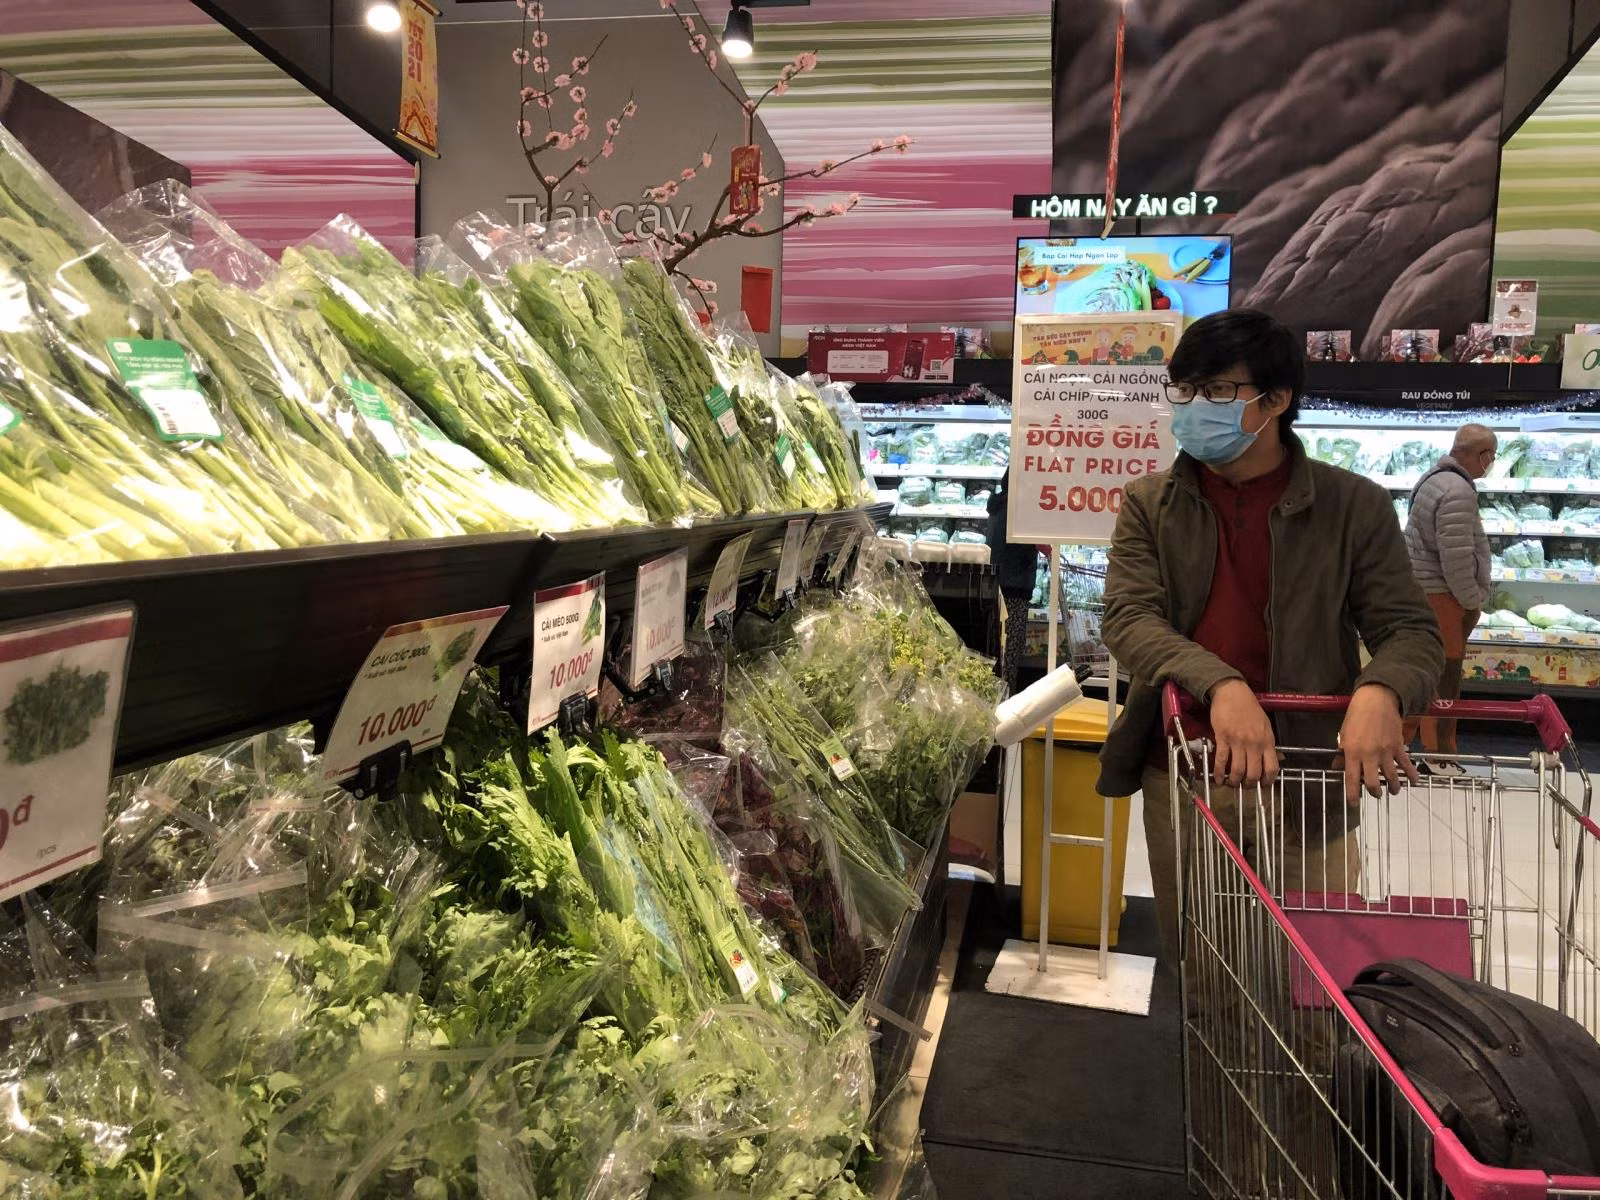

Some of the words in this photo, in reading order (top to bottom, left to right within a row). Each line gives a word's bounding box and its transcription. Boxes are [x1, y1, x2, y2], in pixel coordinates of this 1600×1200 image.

[1031, 195, 1080, 218] HÔM
[1135, 193, 1167, 217] ĂN
[1172, 191, 1197, 216] GÌ
[1203, 195, 1218, 215] ?
[1024, 370, 1045, 384] CẢI
[1093, 370, 1115, 385] CẢI
[1033, 387, 1055, 401] CẢI
[1123, 391, 1160, 402] XANH
[1401, 391, 1421, 400] RAU
[1423, 389, 1454, 400] ĐÓNG
[1456, 389, 1471, 400] TÚI
[1077, 409, 1109, 420] 300G
[1026, 413, 1105, 448] ĐỒNG
[1112, 419, 1160, 449] GIÁ
[1024, 455, 1075, 473] FLAT
[1085, 457, 1157, 475] PRICE
